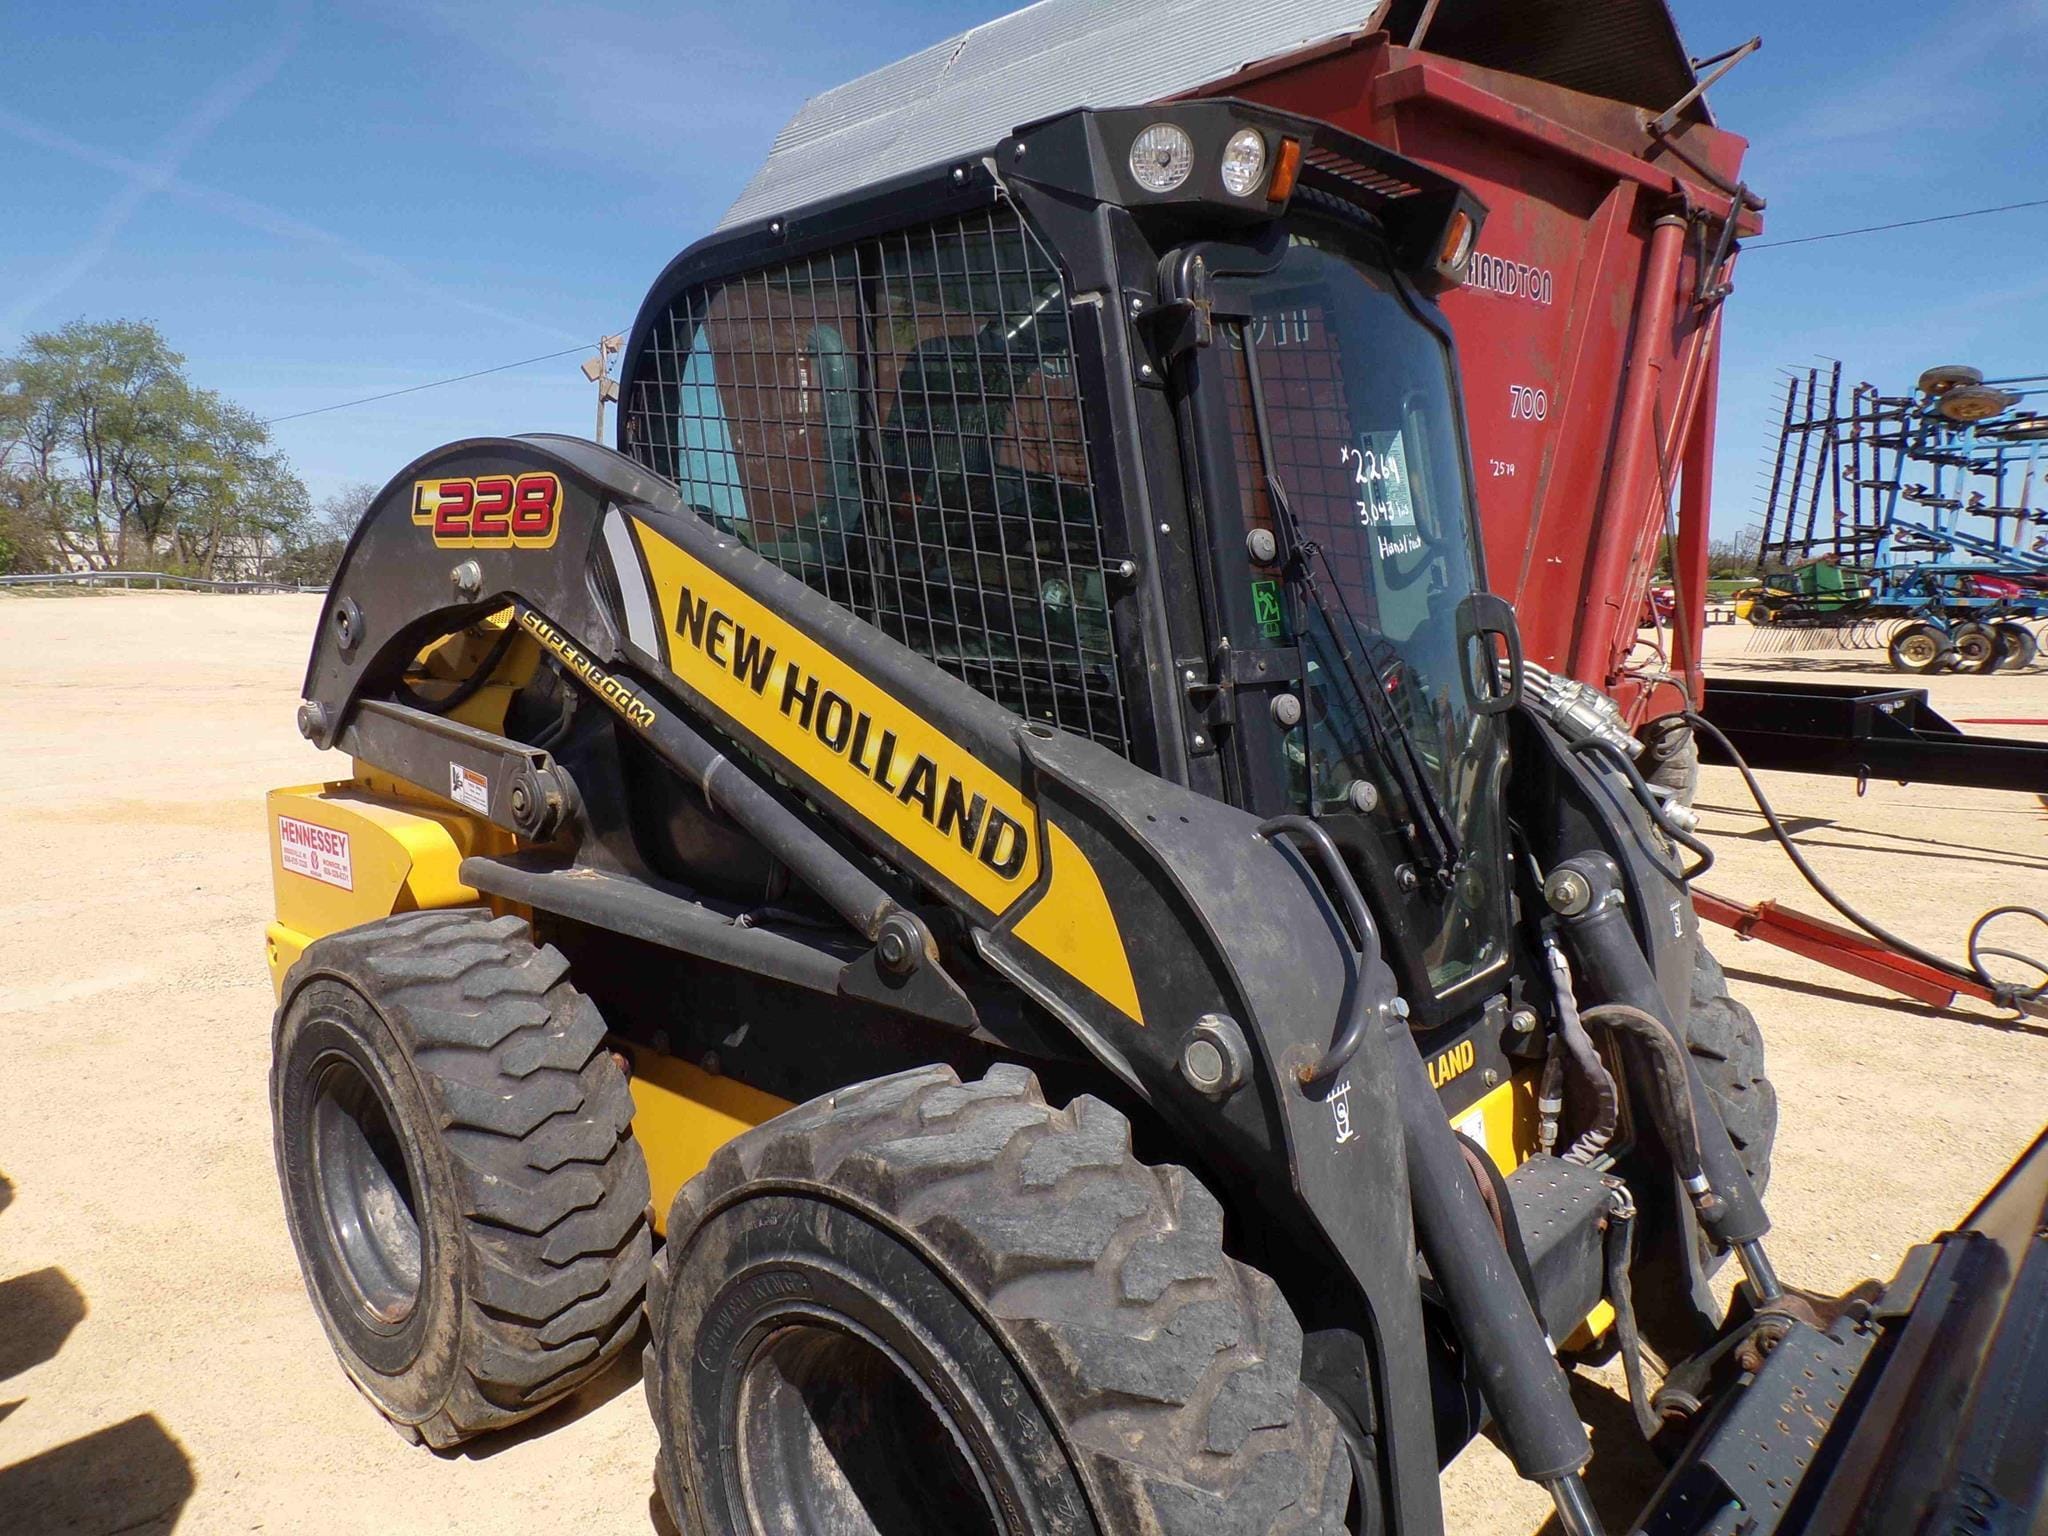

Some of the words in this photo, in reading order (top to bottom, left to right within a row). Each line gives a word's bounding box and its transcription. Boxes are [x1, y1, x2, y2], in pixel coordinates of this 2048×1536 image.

[1462, 252, 1552, 305] HARDTON
[1510, 385, 1547, 421] 700
[412, 472, 563, 548] L228
[521, 610, 656, 728] SUPERBOOM
[674, 583, 778, 698] NEW
[778, 659, 1029, 883] HOLLAND
[281, 819, 346, 858] HENNESSEY
[1428, 1039, 1474, 1089] LAND
